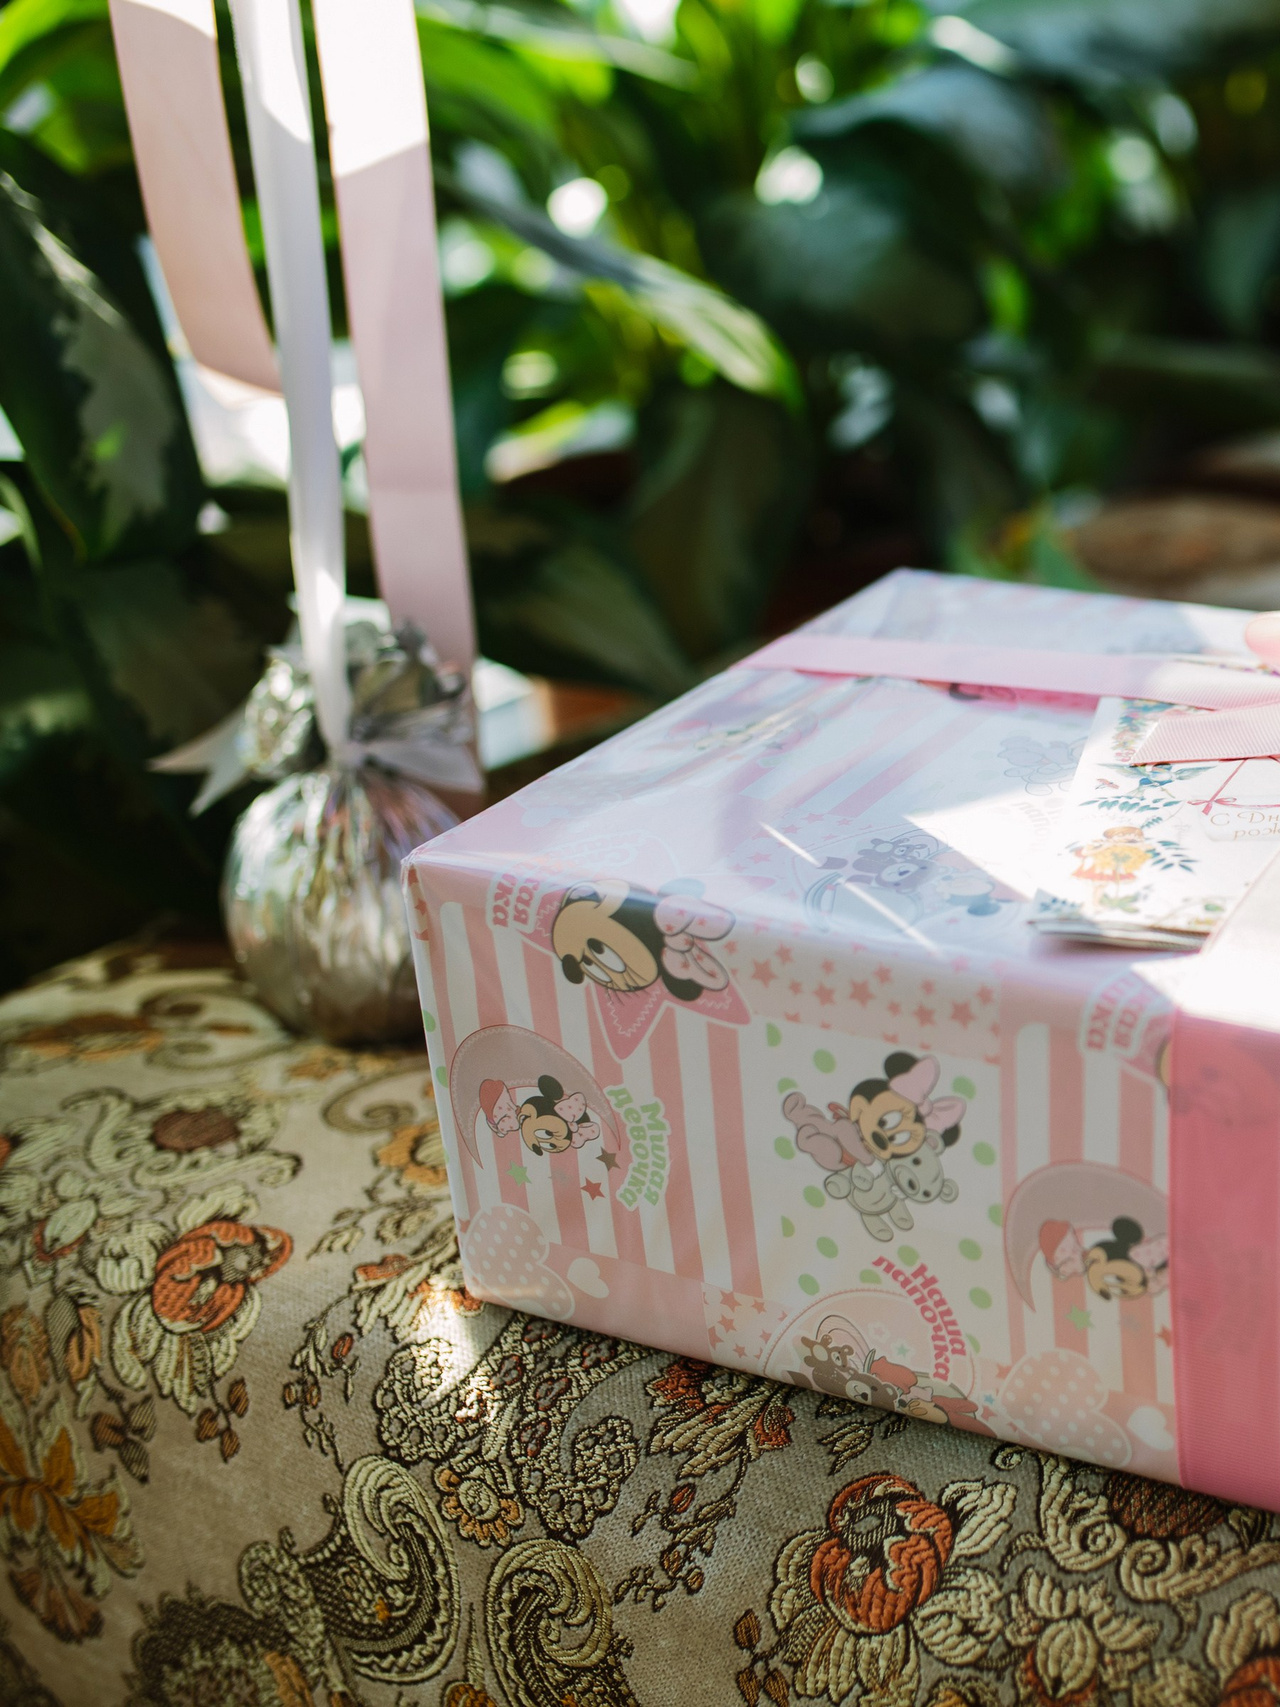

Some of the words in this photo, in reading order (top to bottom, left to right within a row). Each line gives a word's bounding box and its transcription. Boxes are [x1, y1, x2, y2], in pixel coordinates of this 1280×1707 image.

[1210, 812, 1230, 826] С
[606, 1087, 648, 1208] девочка
[640, 1101, 667, 1206] Милая
[872, 1255, 950, 1382] лапочка
[910, 1262, 967, 1357] Наша
